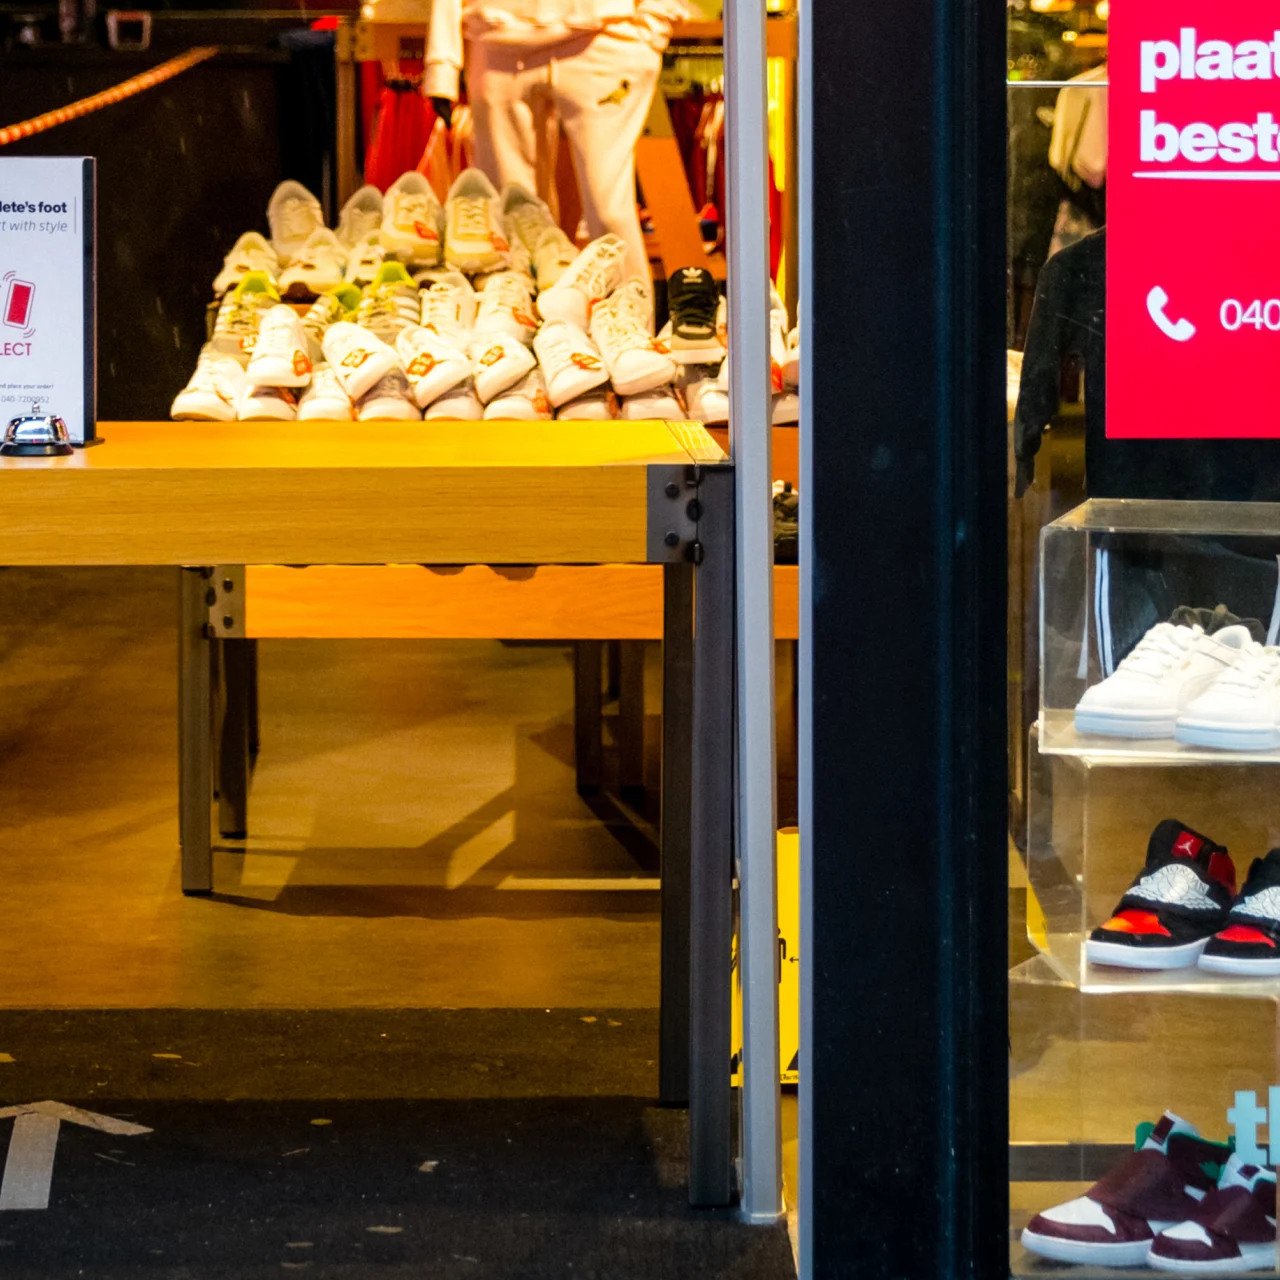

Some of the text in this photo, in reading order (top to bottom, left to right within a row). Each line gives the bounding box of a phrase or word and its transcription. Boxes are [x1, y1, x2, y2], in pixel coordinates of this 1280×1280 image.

[38, 201, 67, 213] foot
[9, 221, 36, 232] with
[39, 221, 68, 234] style
[1, 395, 50, 404] 040-7200952
